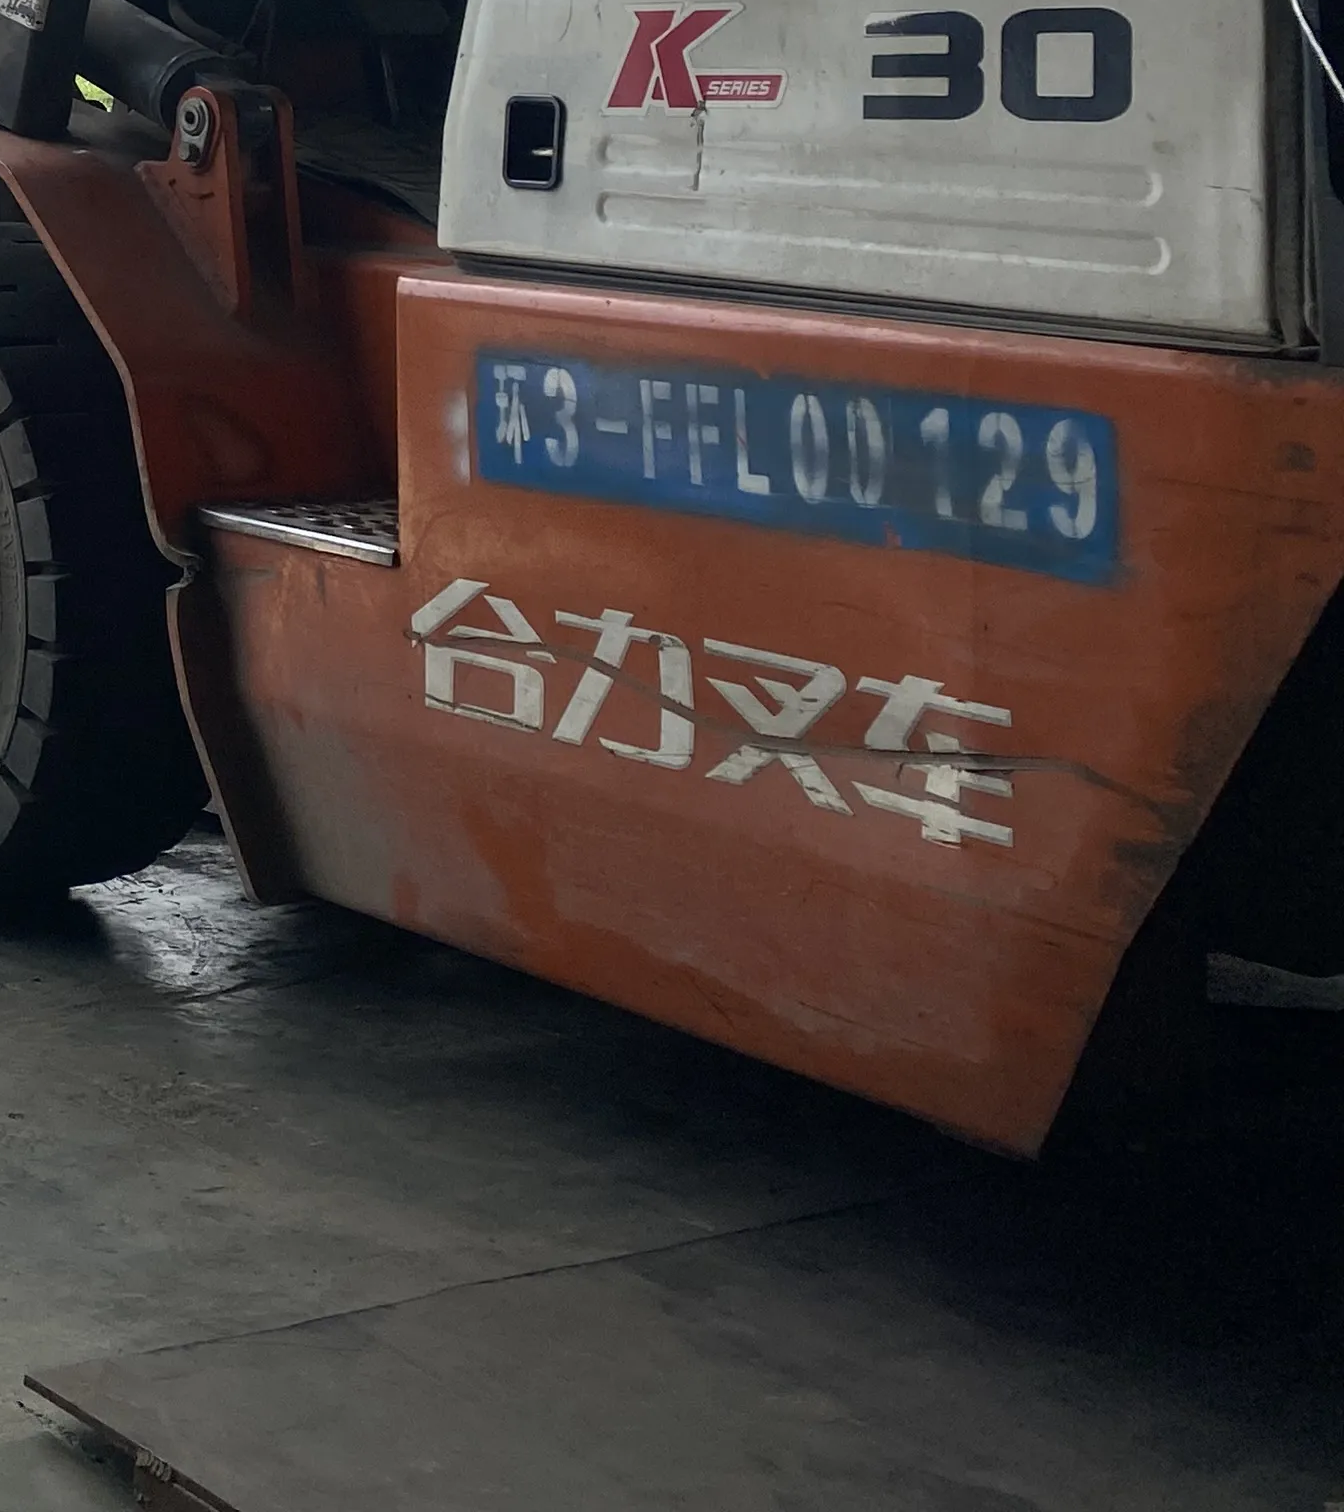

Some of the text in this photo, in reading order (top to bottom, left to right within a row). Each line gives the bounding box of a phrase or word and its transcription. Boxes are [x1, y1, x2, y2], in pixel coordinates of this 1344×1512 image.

[705, 79, 772, 97] SERIES
[863, 6, 1134, 123] 30
[406, 578, 1015, 848] 合力叉车
